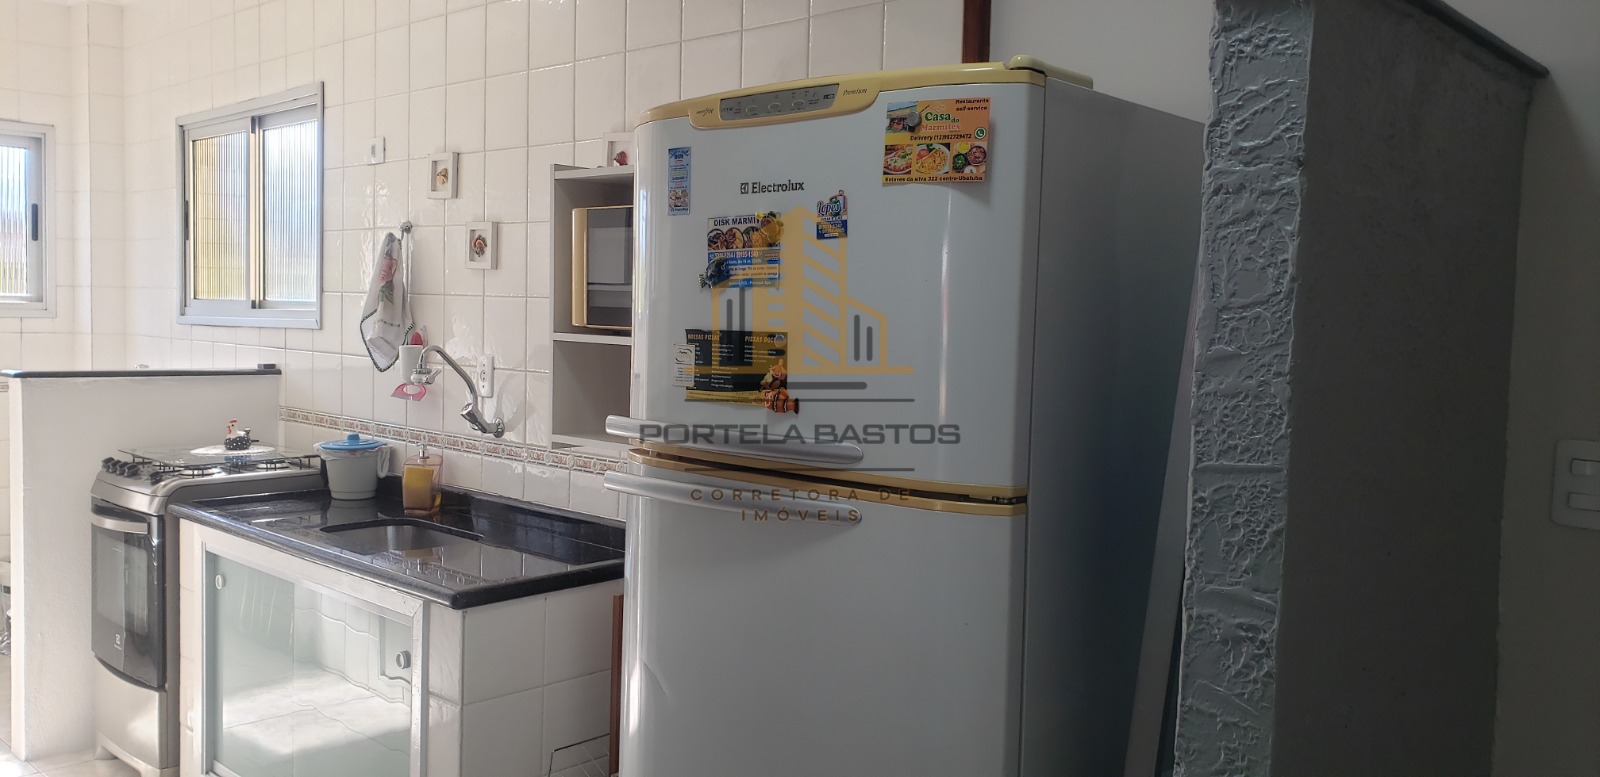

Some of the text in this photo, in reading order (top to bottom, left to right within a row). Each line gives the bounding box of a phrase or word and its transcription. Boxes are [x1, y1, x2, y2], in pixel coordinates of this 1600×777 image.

[924, 111, 951, 122] Casa
[920, 124, 960, 132] Marmitex
[751, 179, 805, 194] Electrolux
[713, 218, 731, 227] DISK
[744, 335, 763, 343] PIZZAS
